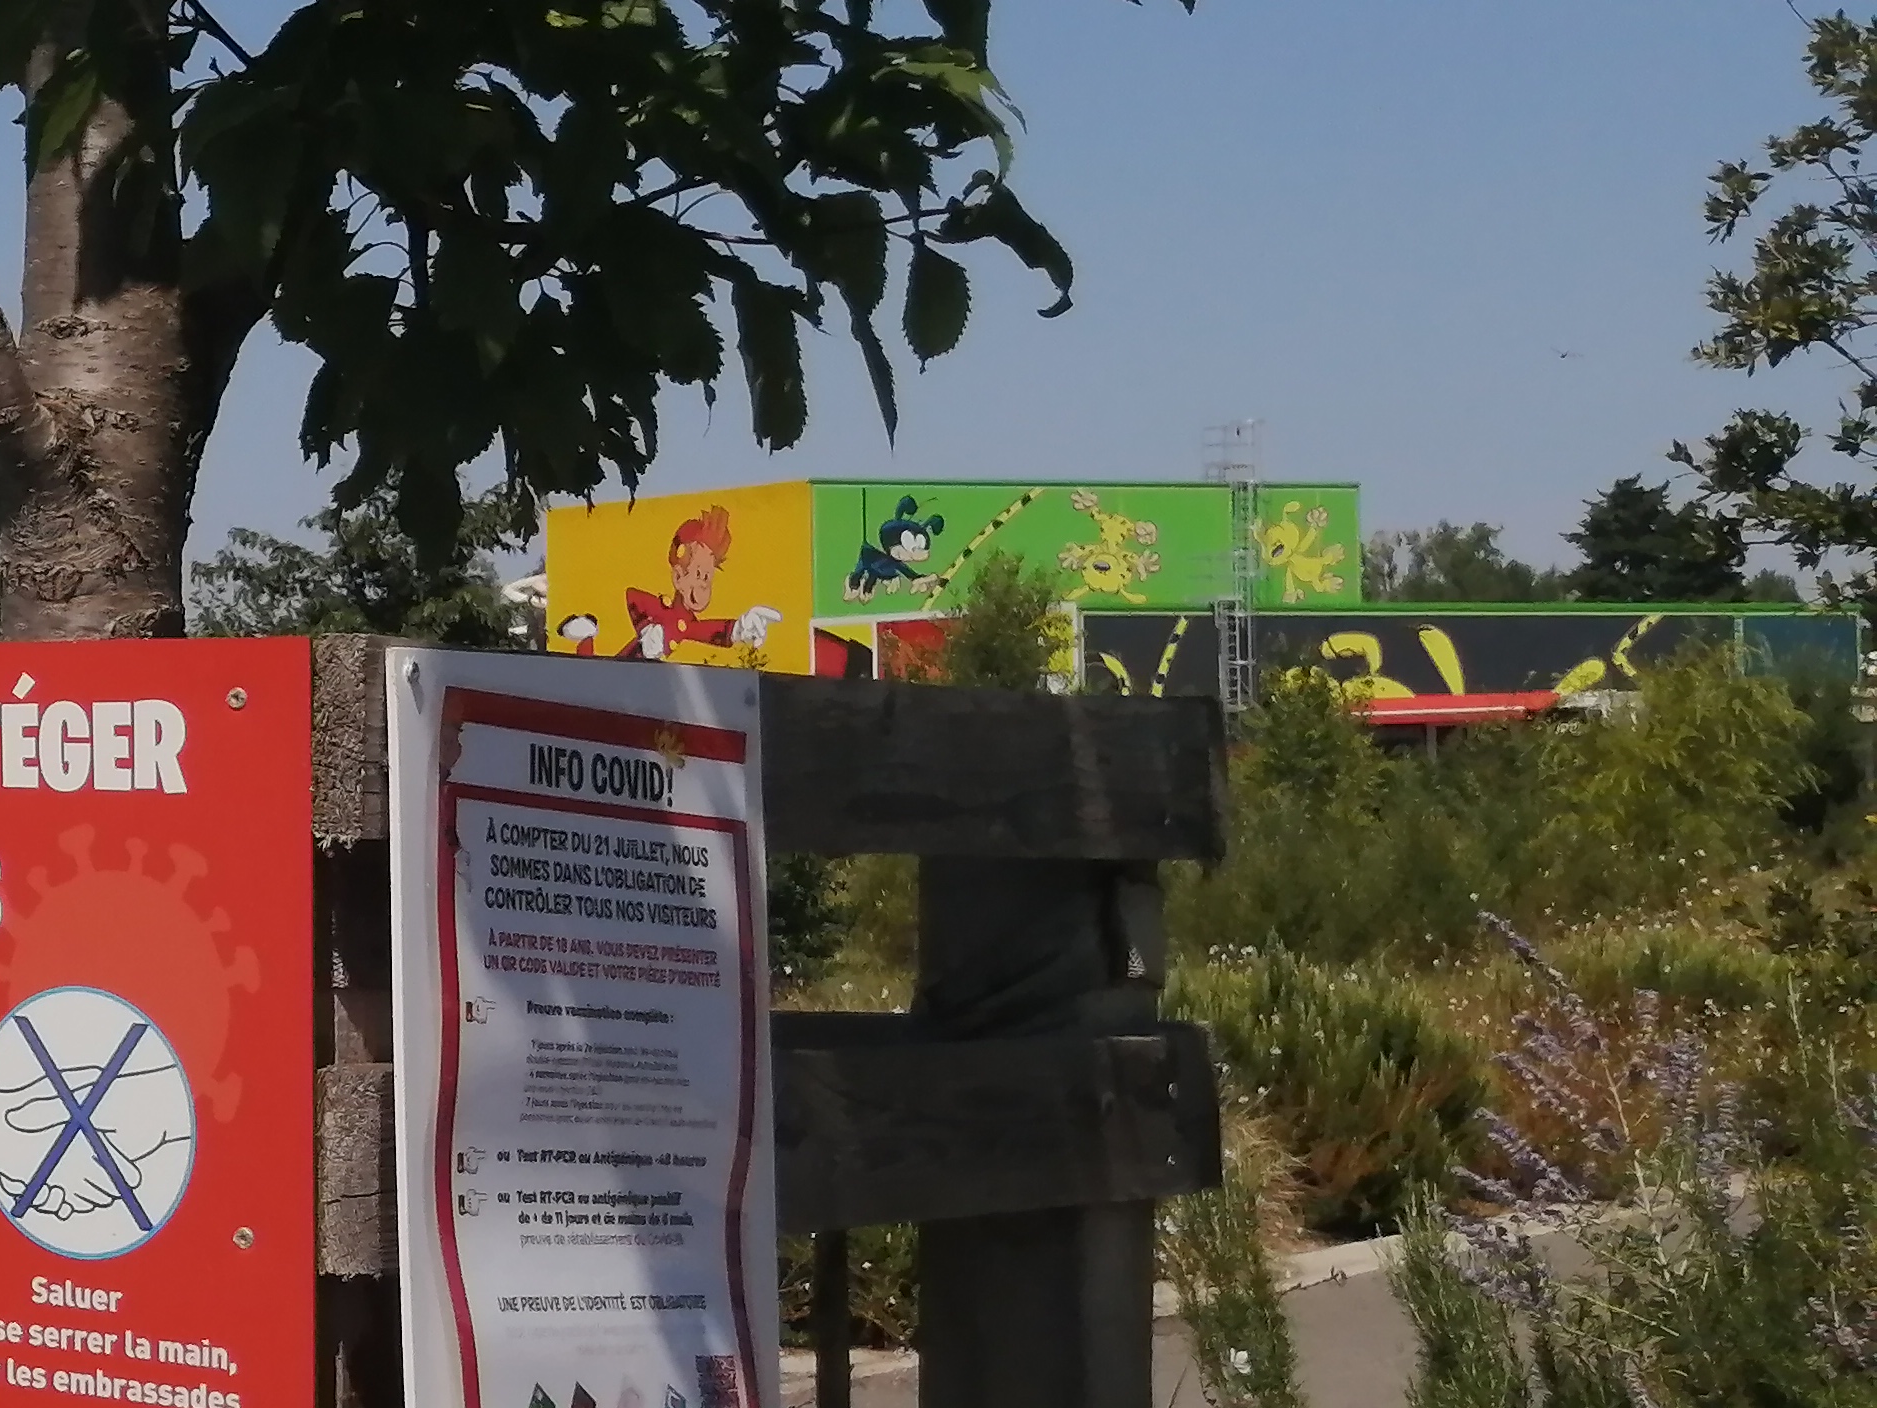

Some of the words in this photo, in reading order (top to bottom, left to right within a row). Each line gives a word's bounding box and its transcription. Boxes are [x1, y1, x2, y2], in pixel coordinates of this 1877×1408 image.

[529, 743, 584, 792] INFO
[500, 822, 568, 851] COMPTER
[571, 831, 591, 855] DU
[594, 834, 610, 857] 21
[613, 836, 670, 867] JUILLET,
[673, 844, 709, 868] NOUS
[490, 854, 550, 882] SOMMES
[553, 861, 592, 886] DANS
[595, 865, 686, 896] L'OBLIGATION
[689, 875, 707, 898] DE
[484, 886, 573, 916] CONTRÔLER
[576, 895, 613, 920] TOUS
[615, 899, 644, 922] NOS
[646, 902, 717, 930] VISITEURS
[498, 930, 537, 950] PARTIR
[539, 934, 554, 952] DE
[497, 1150, 510, 1163] ou
[30, 1275, 123, 1313] Saluer
[497, 1295, 519, 1312] UNE
[520, 1295, 561, 1312] PREUVE
[28, 1323, 118, 1355] serrer
[124, 1329, 151, 1360] la
[158, 1338, 238, 1376] main,
[6, 1357, 46, 1389] les
